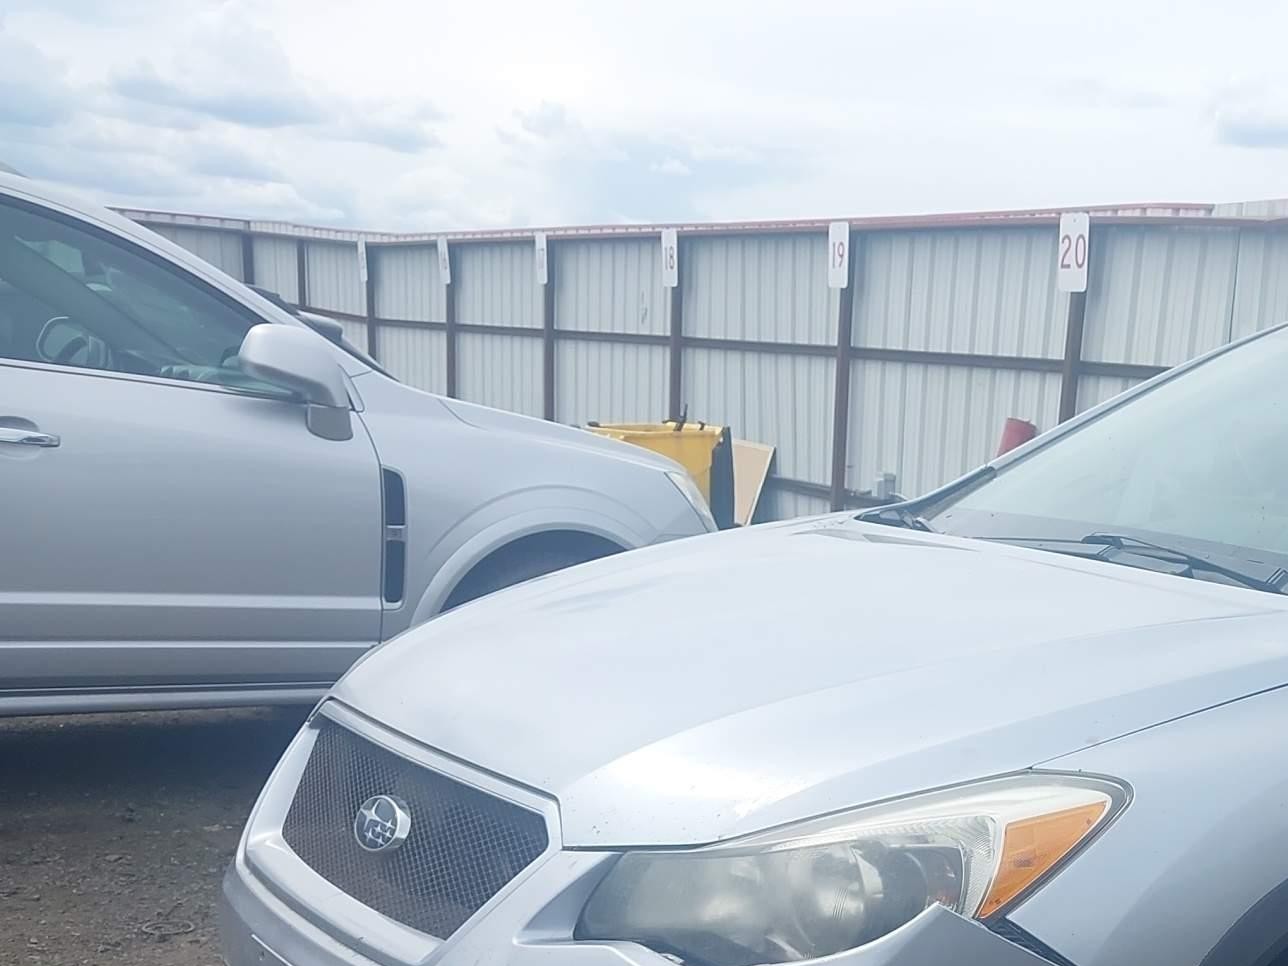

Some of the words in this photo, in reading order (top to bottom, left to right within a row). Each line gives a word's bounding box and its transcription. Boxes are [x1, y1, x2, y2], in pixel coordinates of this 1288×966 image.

[664, 245, 675, 270] 18
[832, 241, 845, 269] 19
[1060, 233, 1086, 269] 20
